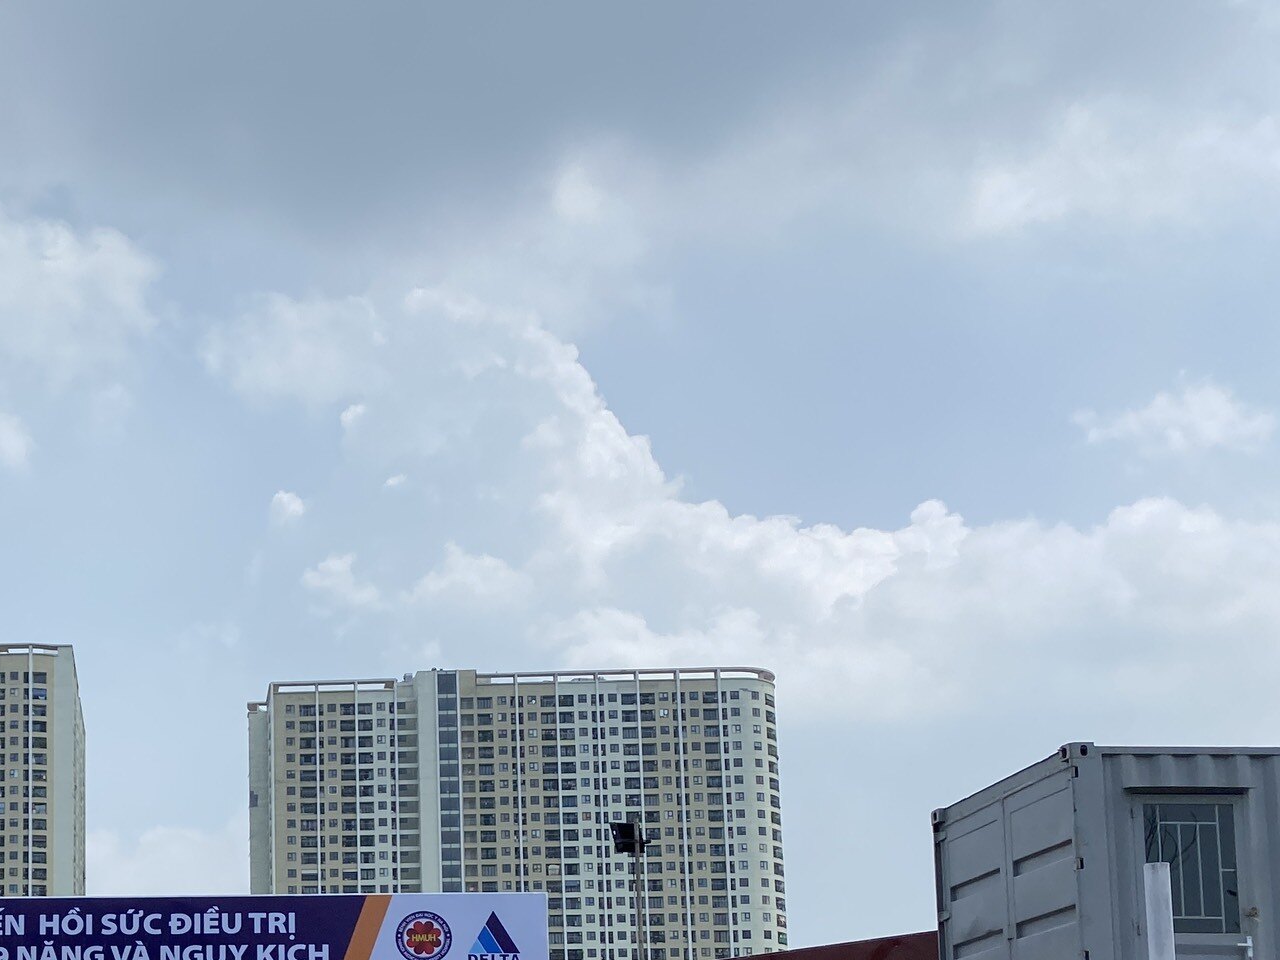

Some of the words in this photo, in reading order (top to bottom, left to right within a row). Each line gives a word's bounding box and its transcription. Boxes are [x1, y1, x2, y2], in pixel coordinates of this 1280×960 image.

[39, 907, 93, 935] HỒI
[101, 908, 162, 934] SỨC
[169, 906, 242, 934] ĐIỀU
[248, 912, 295, 941] TRỊ
